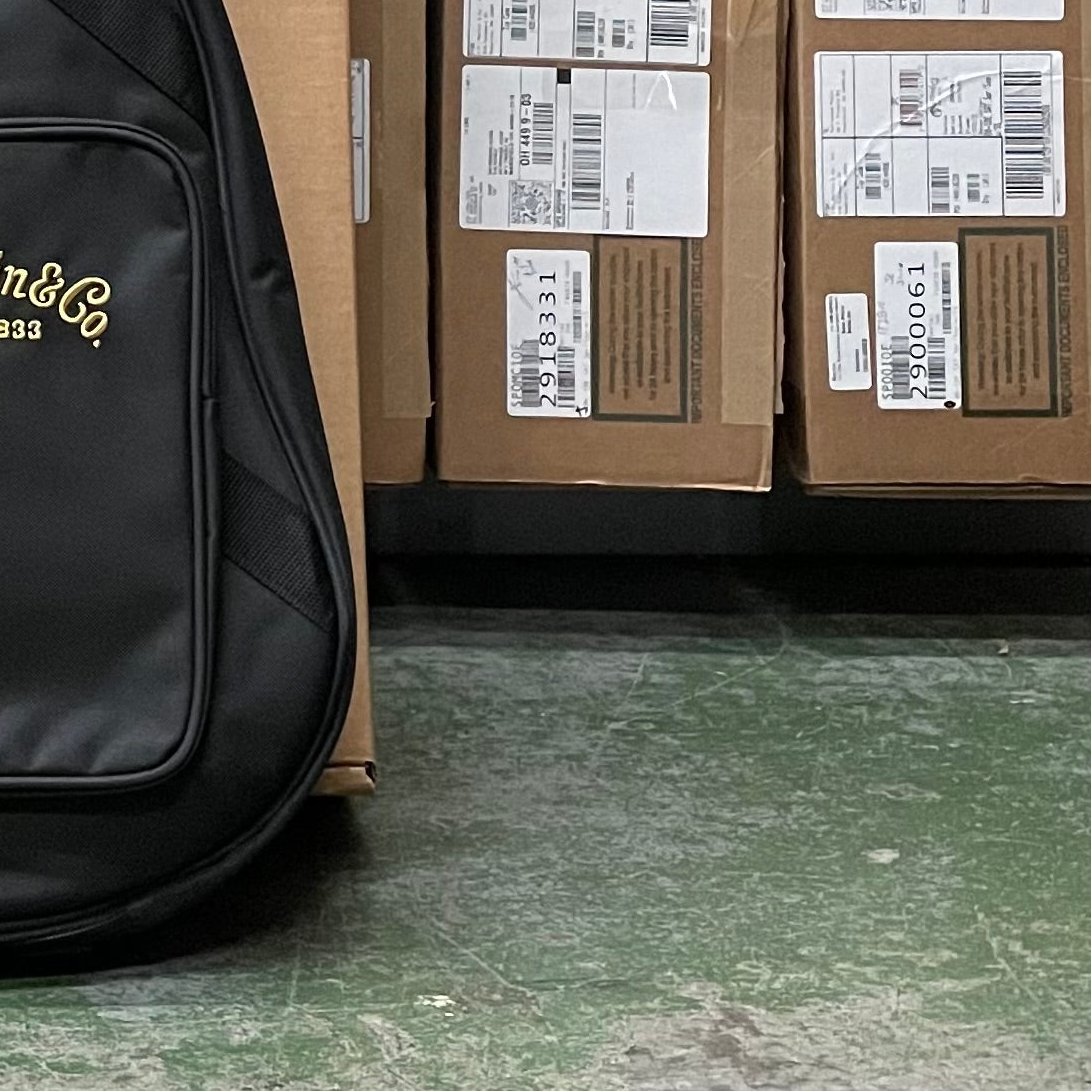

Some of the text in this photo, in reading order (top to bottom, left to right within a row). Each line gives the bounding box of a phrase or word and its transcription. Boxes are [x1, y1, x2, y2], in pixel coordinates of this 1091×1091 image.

[520, 128, 530, 147] 449
[520, 151, 530, 166] OH
[539, 271, 556, 407] 2918331
[908, 263, 927, 399] 2900061
